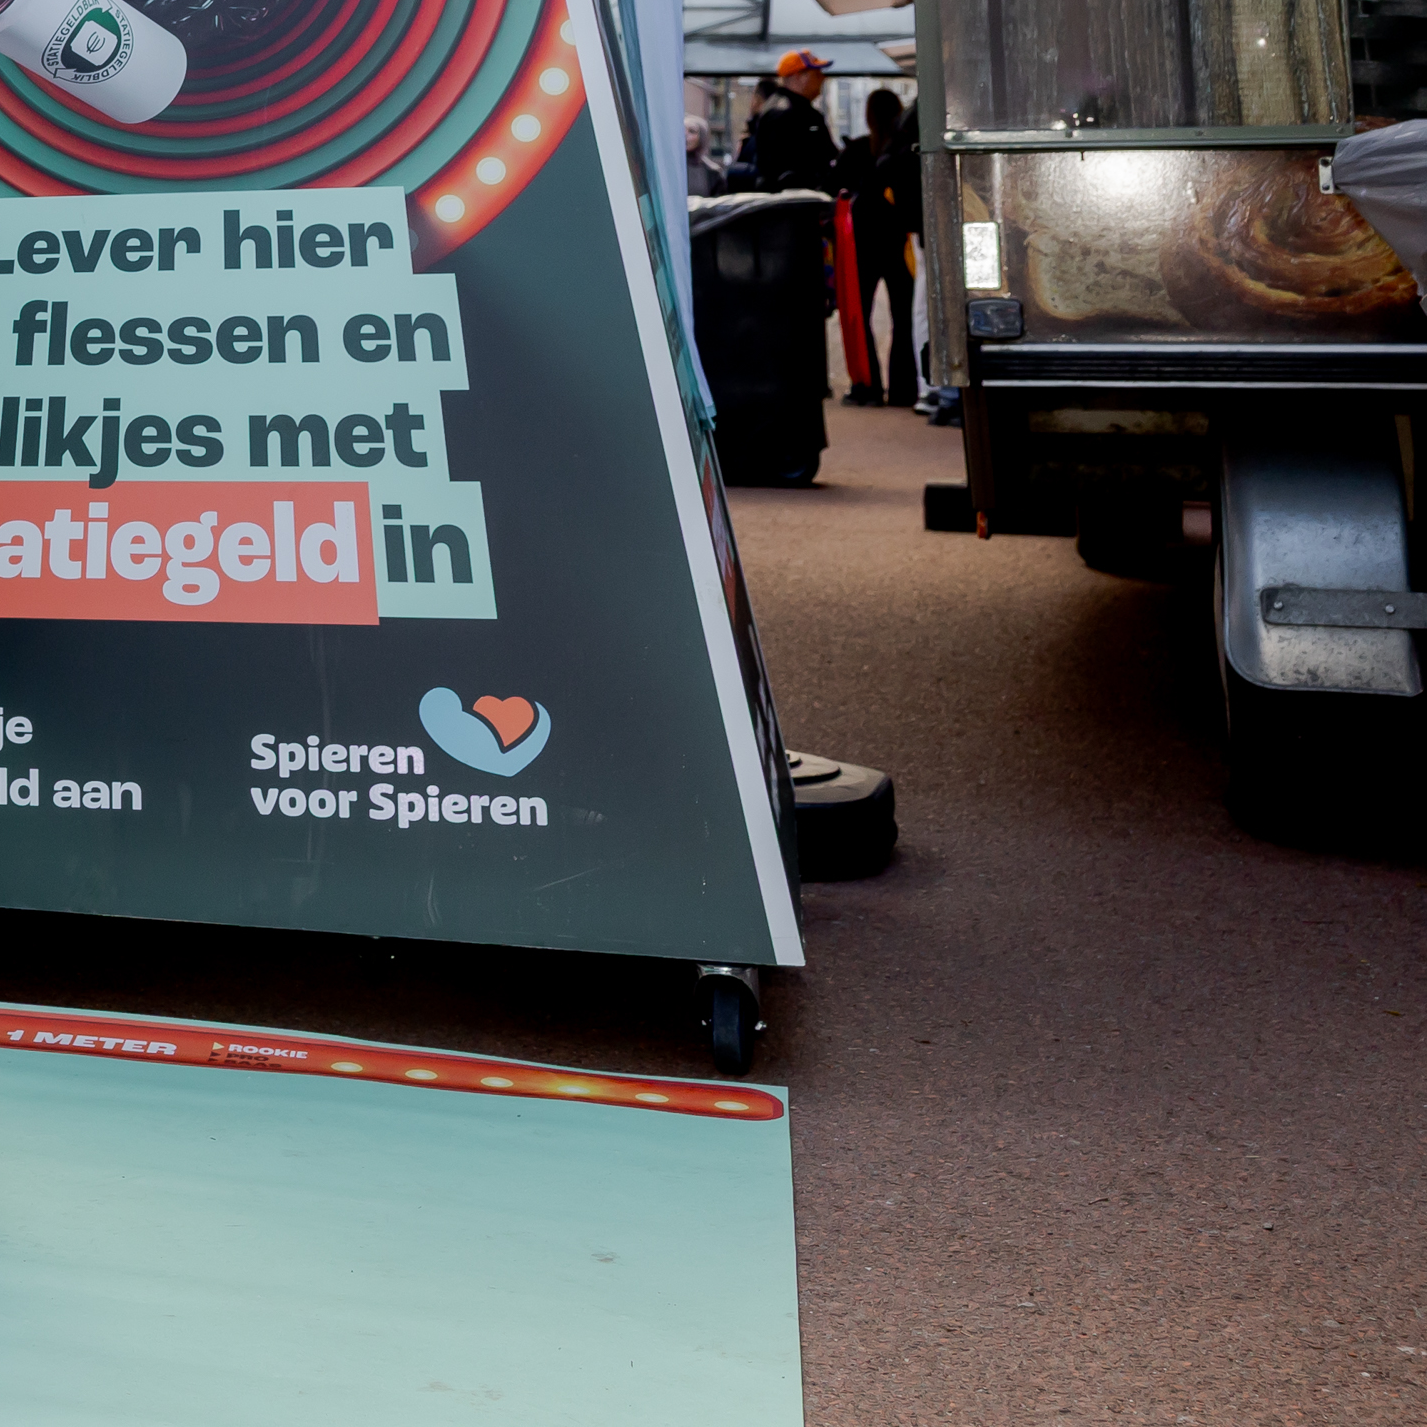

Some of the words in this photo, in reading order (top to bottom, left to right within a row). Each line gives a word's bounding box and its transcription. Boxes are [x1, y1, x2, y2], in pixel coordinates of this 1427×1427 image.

[71, 8, 131, 82] STATIEGELDBLIK
[222, 209, 394, 270] hier
[12, 299, 320, 367] flessen
[342, 312, 452, 363] en
[248, 402, 429, 468] met
[381, 504, 474, 584] in
[250, 734, 425, 778] Spieren
[53, 777, 143, 811] aan
[250, 787, 358, 819] voor
[368, 783, 549, 829] Spieren
[6, 1029, 25, 1041] 1
[33, 1031, 178, 1056] METER
[228, 1043, 308, 1059] ROOKIE
